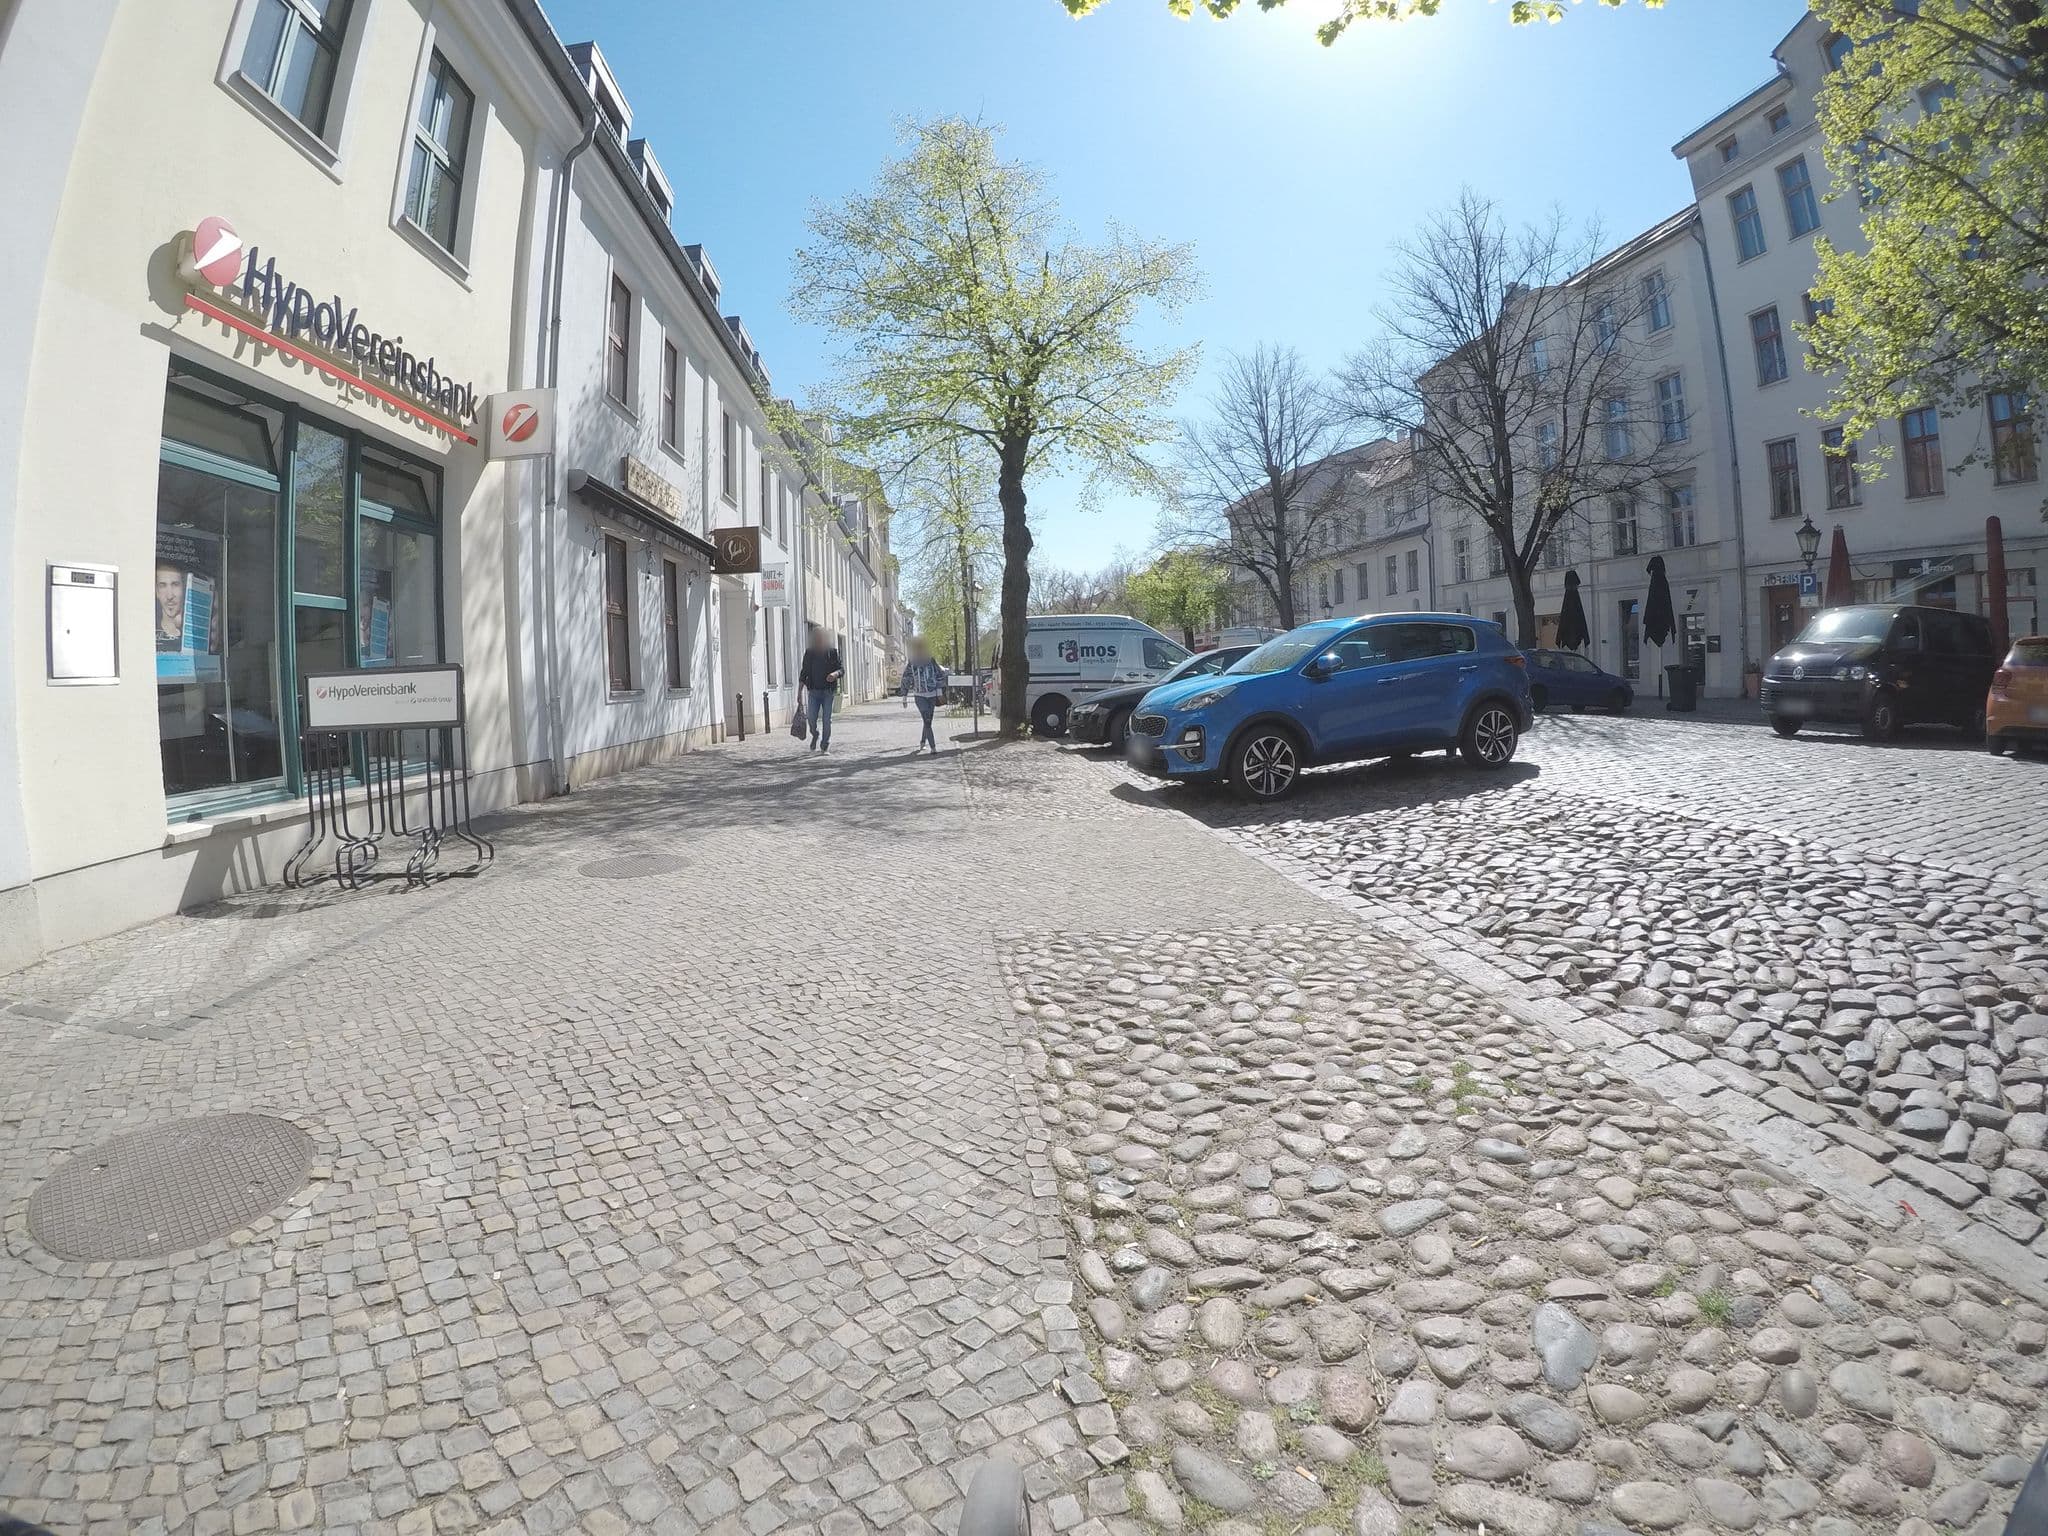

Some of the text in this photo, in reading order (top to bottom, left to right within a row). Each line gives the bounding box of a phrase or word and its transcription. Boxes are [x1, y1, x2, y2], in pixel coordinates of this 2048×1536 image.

[243, 246, 479, 424] HypoVereinsbank
[1803, 576, 1813, 592] P
[1058, 641, 1117, 663] famos
[328, 682, 417, 701] HypoVereinsbank
